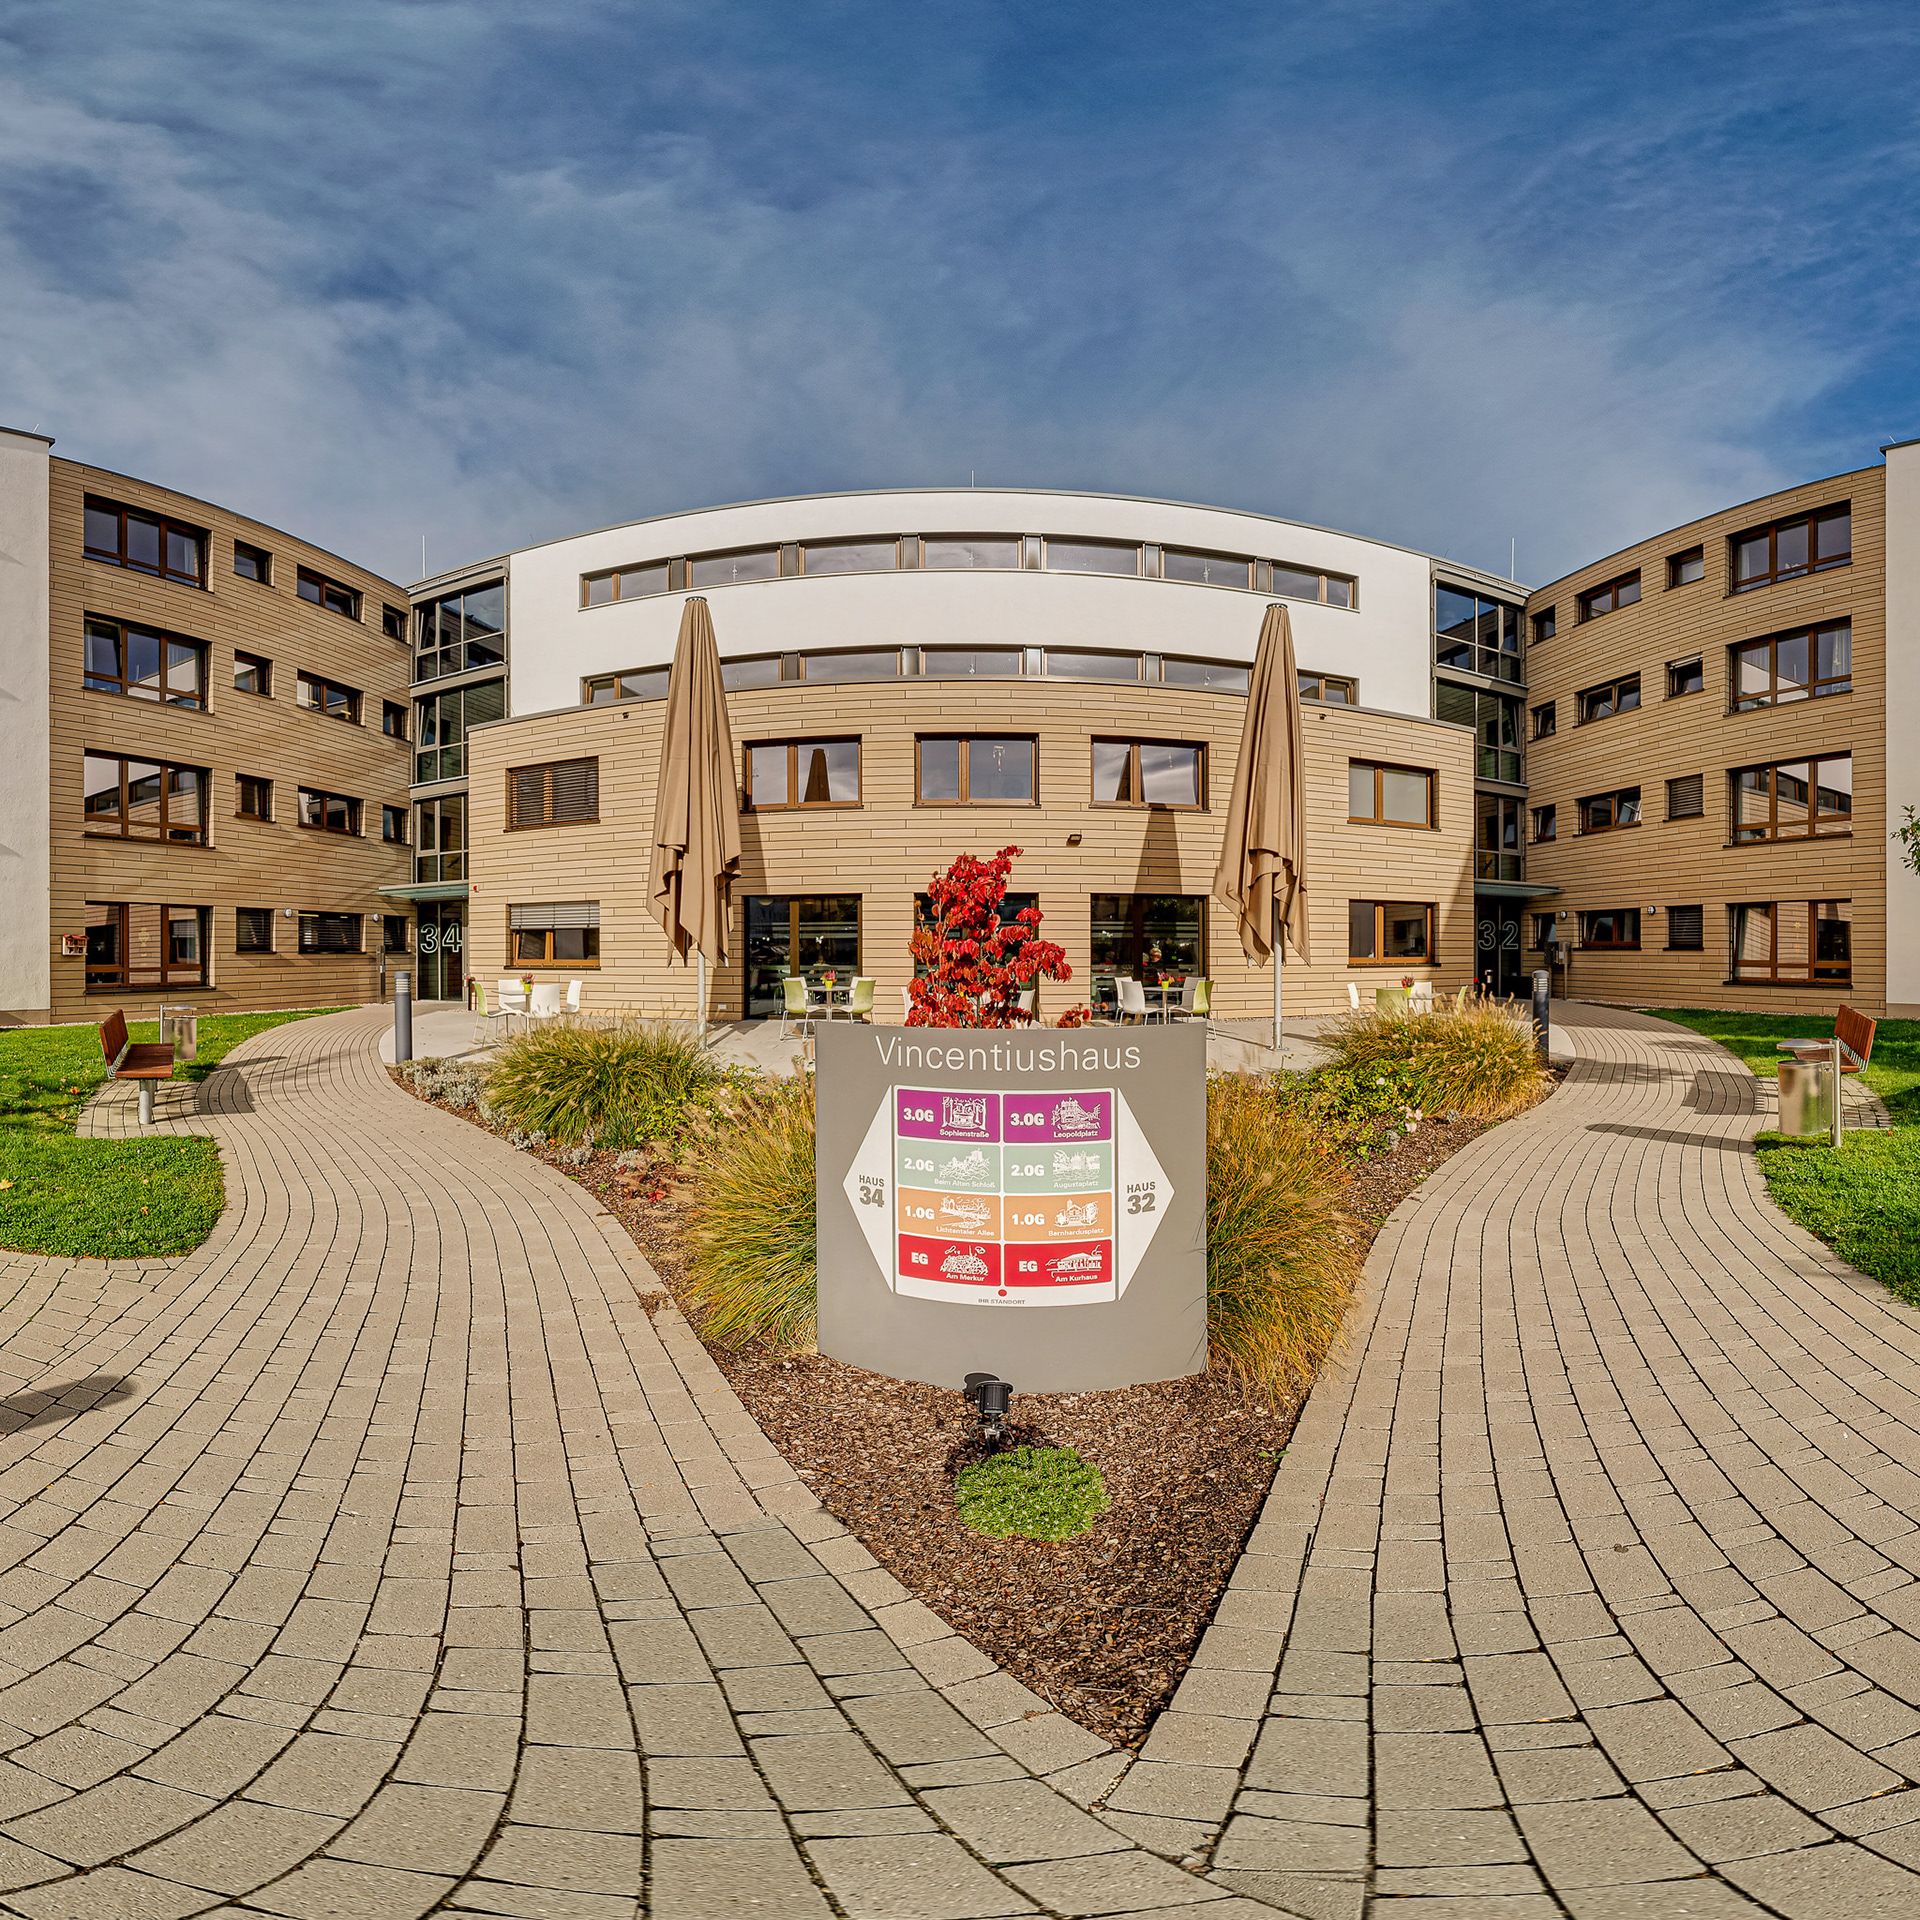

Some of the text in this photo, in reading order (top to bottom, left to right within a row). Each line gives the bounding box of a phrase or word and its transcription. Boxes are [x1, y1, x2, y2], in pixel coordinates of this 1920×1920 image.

[420, 923, 462, 953] 34
[1478, 920, 1519, 950] 32
[875, 1035, 1141, 1072] Vincentiushaus
[939, 1128, 990, 1138] Sophienstraße
[1053, 1129, 1099, 1139] Leopoldplatz
[858, 1174, 885, 1188] HAUS
[934, 1178, 951, 1186] Beim
[952, 1179, 970, 1187] Alten
[1053, 1180, 1099, 1189] Augustaplatz
[1126, 1181, 1156, 1194] HAUS
[859, 1185, 885, 1208] 34
[1127, 1192, 1156, 1215] 32
[936, 1226, 976, 1235] Lichtentaler
[1048, 1227, 1105, 1237] Bernhardusplatz
[911, 1251, 929, 1265] EG
[1018, 1260, 1038, 1272] EG
[959, 1274, 985, 1282] Merkur
[1069, 1274, 1098, 1282] Kurhaus
